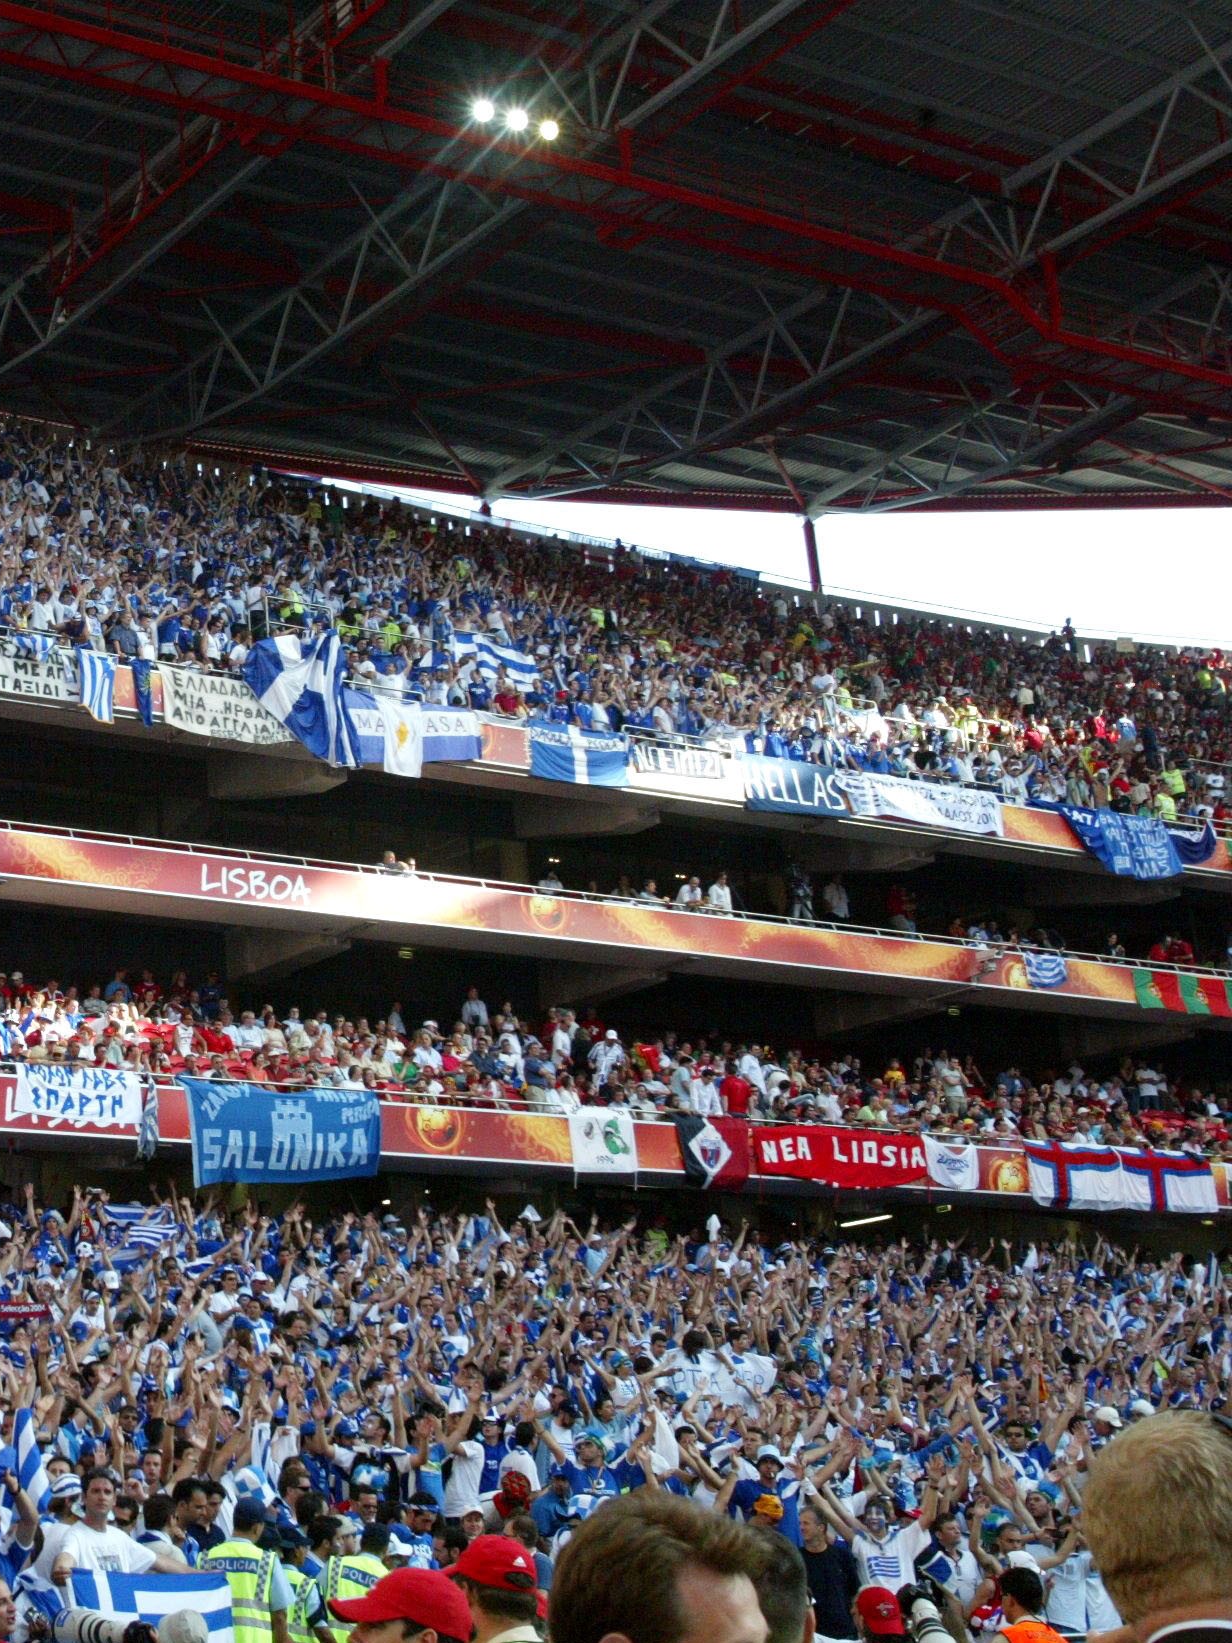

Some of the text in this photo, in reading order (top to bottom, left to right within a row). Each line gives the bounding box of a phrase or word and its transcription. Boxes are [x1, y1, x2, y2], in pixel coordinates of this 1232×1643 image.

[742, 762, 845, 810] HELLAS
[200, 863, 311, 905] LISBOA
[202, 1127, 368, 1171] SALONIKA
[761, 1136, 813, 1163] NEA
[831, 1136, 927, 1169] LIOSIA
[209, 1559, 258, 1572] POLICIA
[342, 1566, 380, 1589] POLIC
